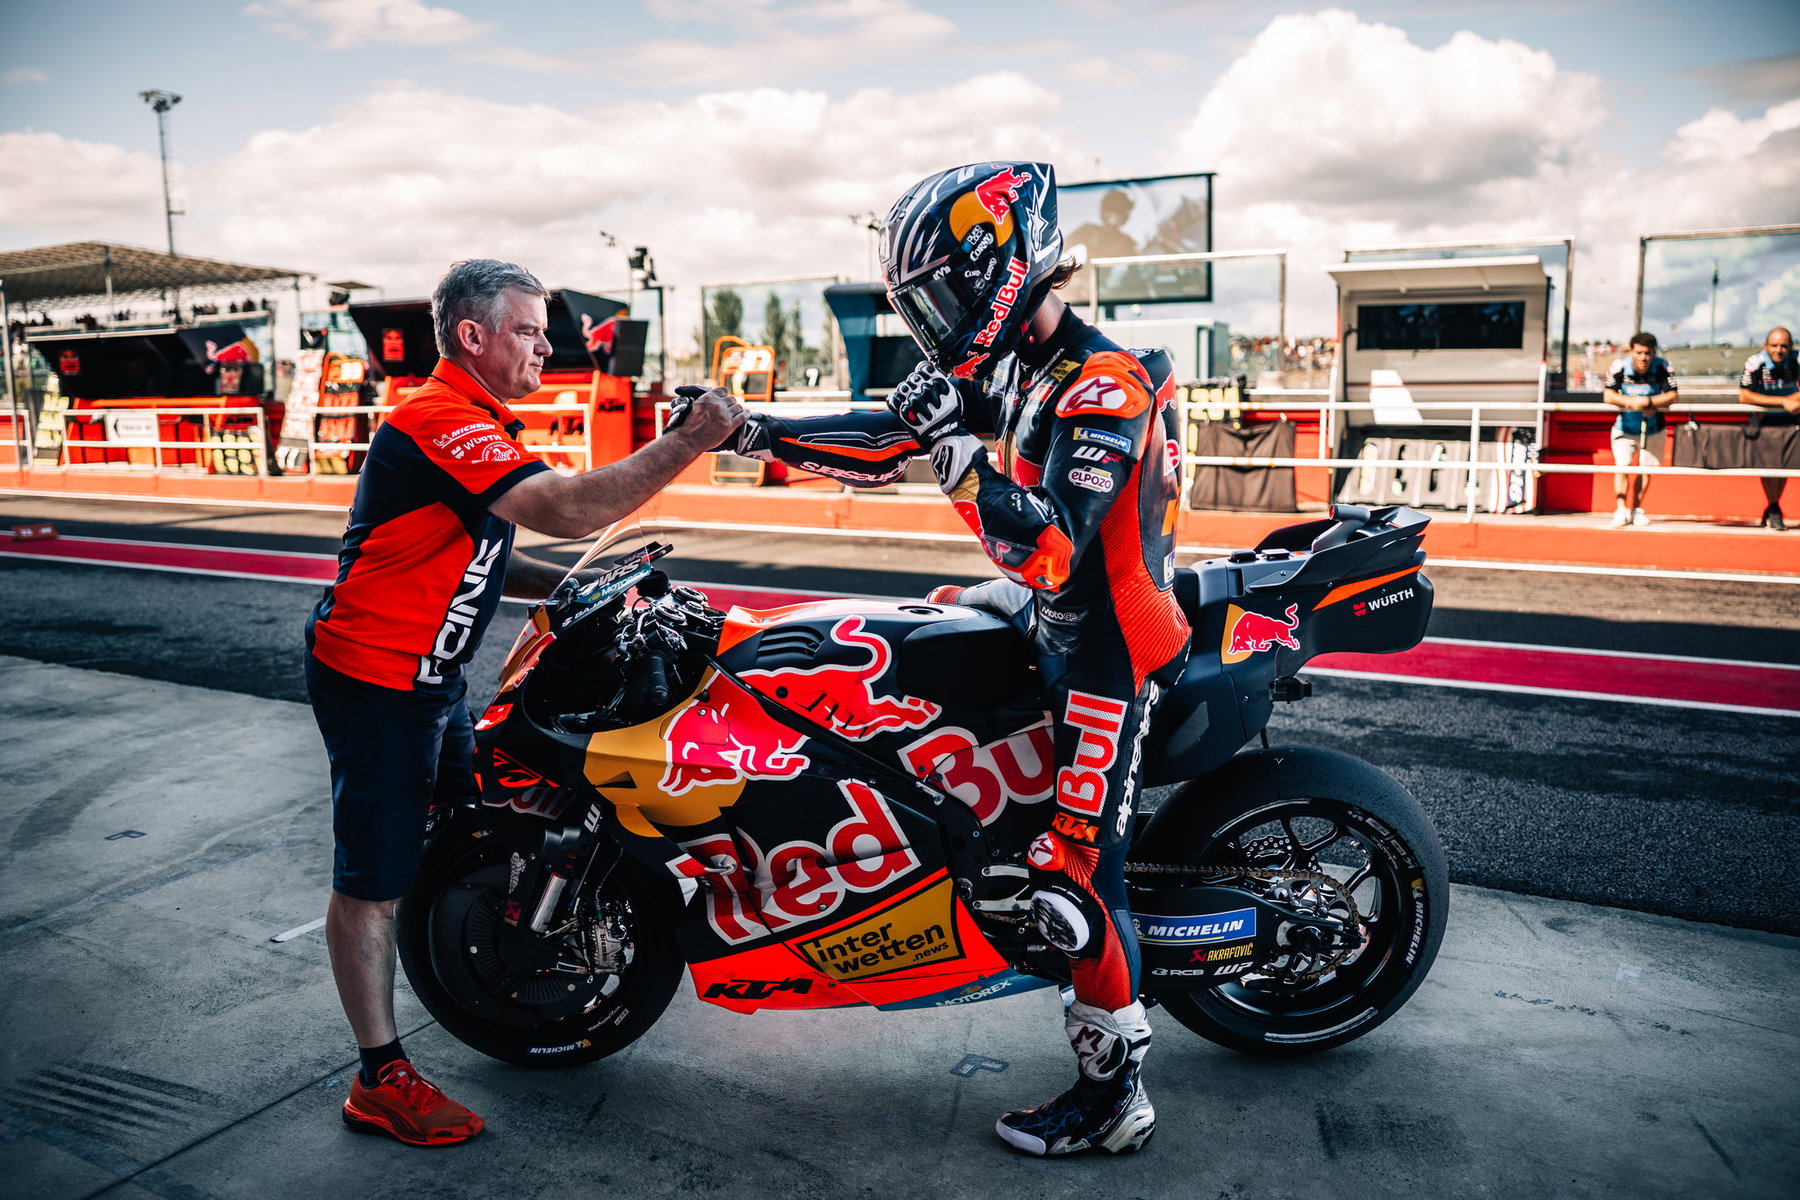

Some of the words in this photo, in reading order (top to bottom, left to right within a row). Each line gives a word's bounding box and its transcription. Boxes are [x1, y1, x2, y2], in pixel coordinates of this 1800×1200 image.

[970, 233, 994, 261] CORNY
[984, 257, 997, 280] CORNY
[974, 300, 1011, 347] Red
[997, 257, 1030, 308] Bull
[451, 423, 496, 438] MICHELIN
[1089, 432, 1127, 447] MICHELIN
[598, 562, 639, 587] WRS
[1041, 605, 1077, 621] MotoGP
[1368, 588, 1414, 611] WÜRTH
[1057, 689, 1128, 817] Bull
[1116, 680, 1159, 836] alpinestars
[1051, 812, 1099, 842] KTM
[666, 778, 922, 946] Red
[1148, 920, 1244, 937] MICHELIN
[1407, 901, 1424, 965] MICHELIN
[600, 934, 608, 961] brembo
[812, 922, 893, 963] inter
[833, 924, 945, 975] wetten
[703, 977, 814, 1000] KTM
[935, 979, 1013, 1007] MOTOREX
[530, 1044, 575, 1054] MICHELIN
